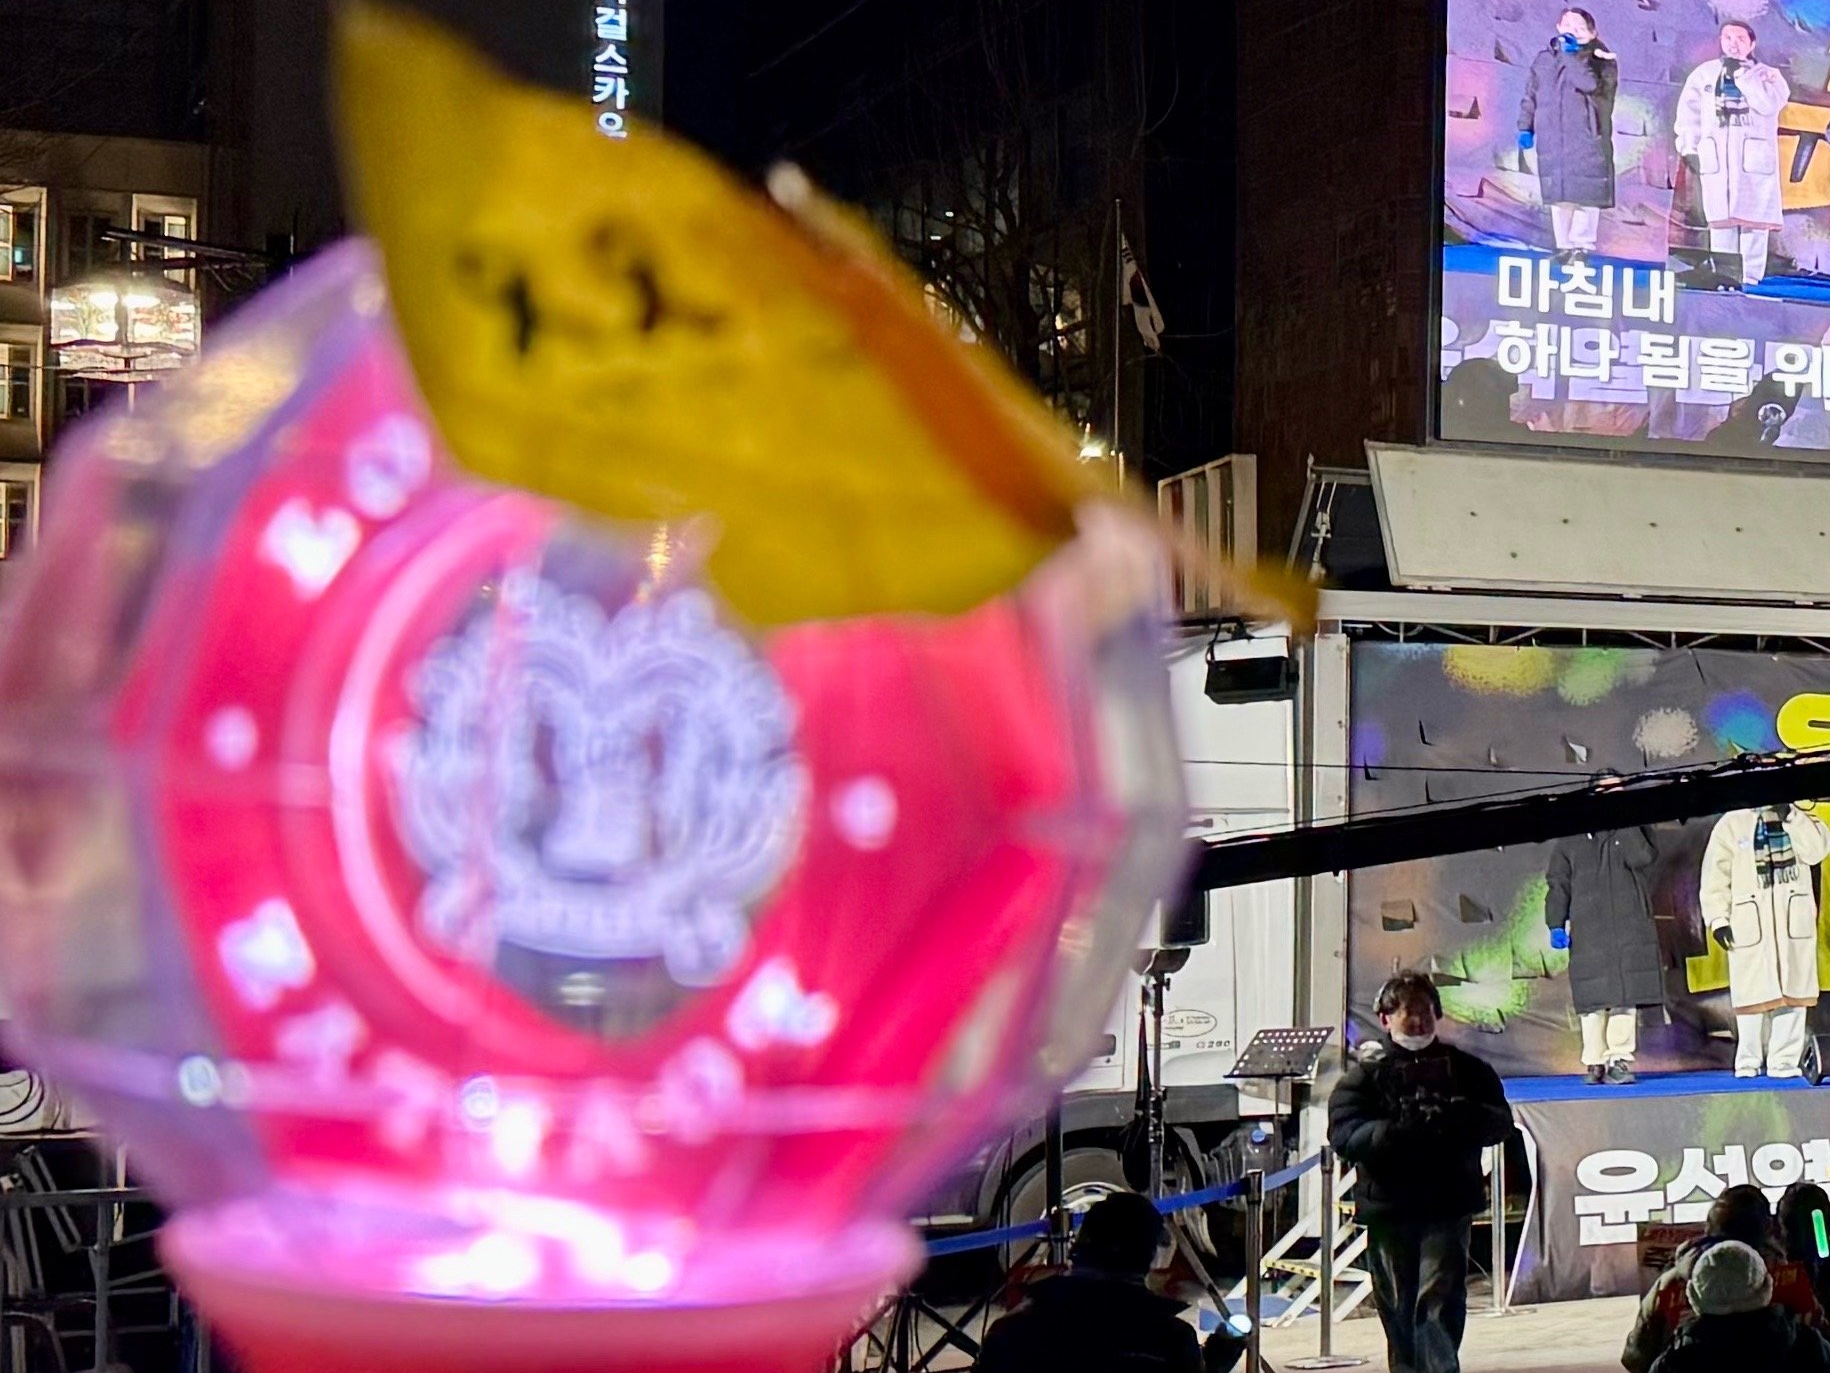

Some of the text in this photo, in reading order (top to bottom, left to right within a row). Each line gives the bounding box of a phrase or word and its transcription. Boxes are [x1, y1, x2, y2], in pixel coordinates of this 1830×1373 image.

[1498, 255, 1675, 323] 마침내
[1495, 321, 1618, 382] 하나
[1637, 334, 1754, 394] 됨을
